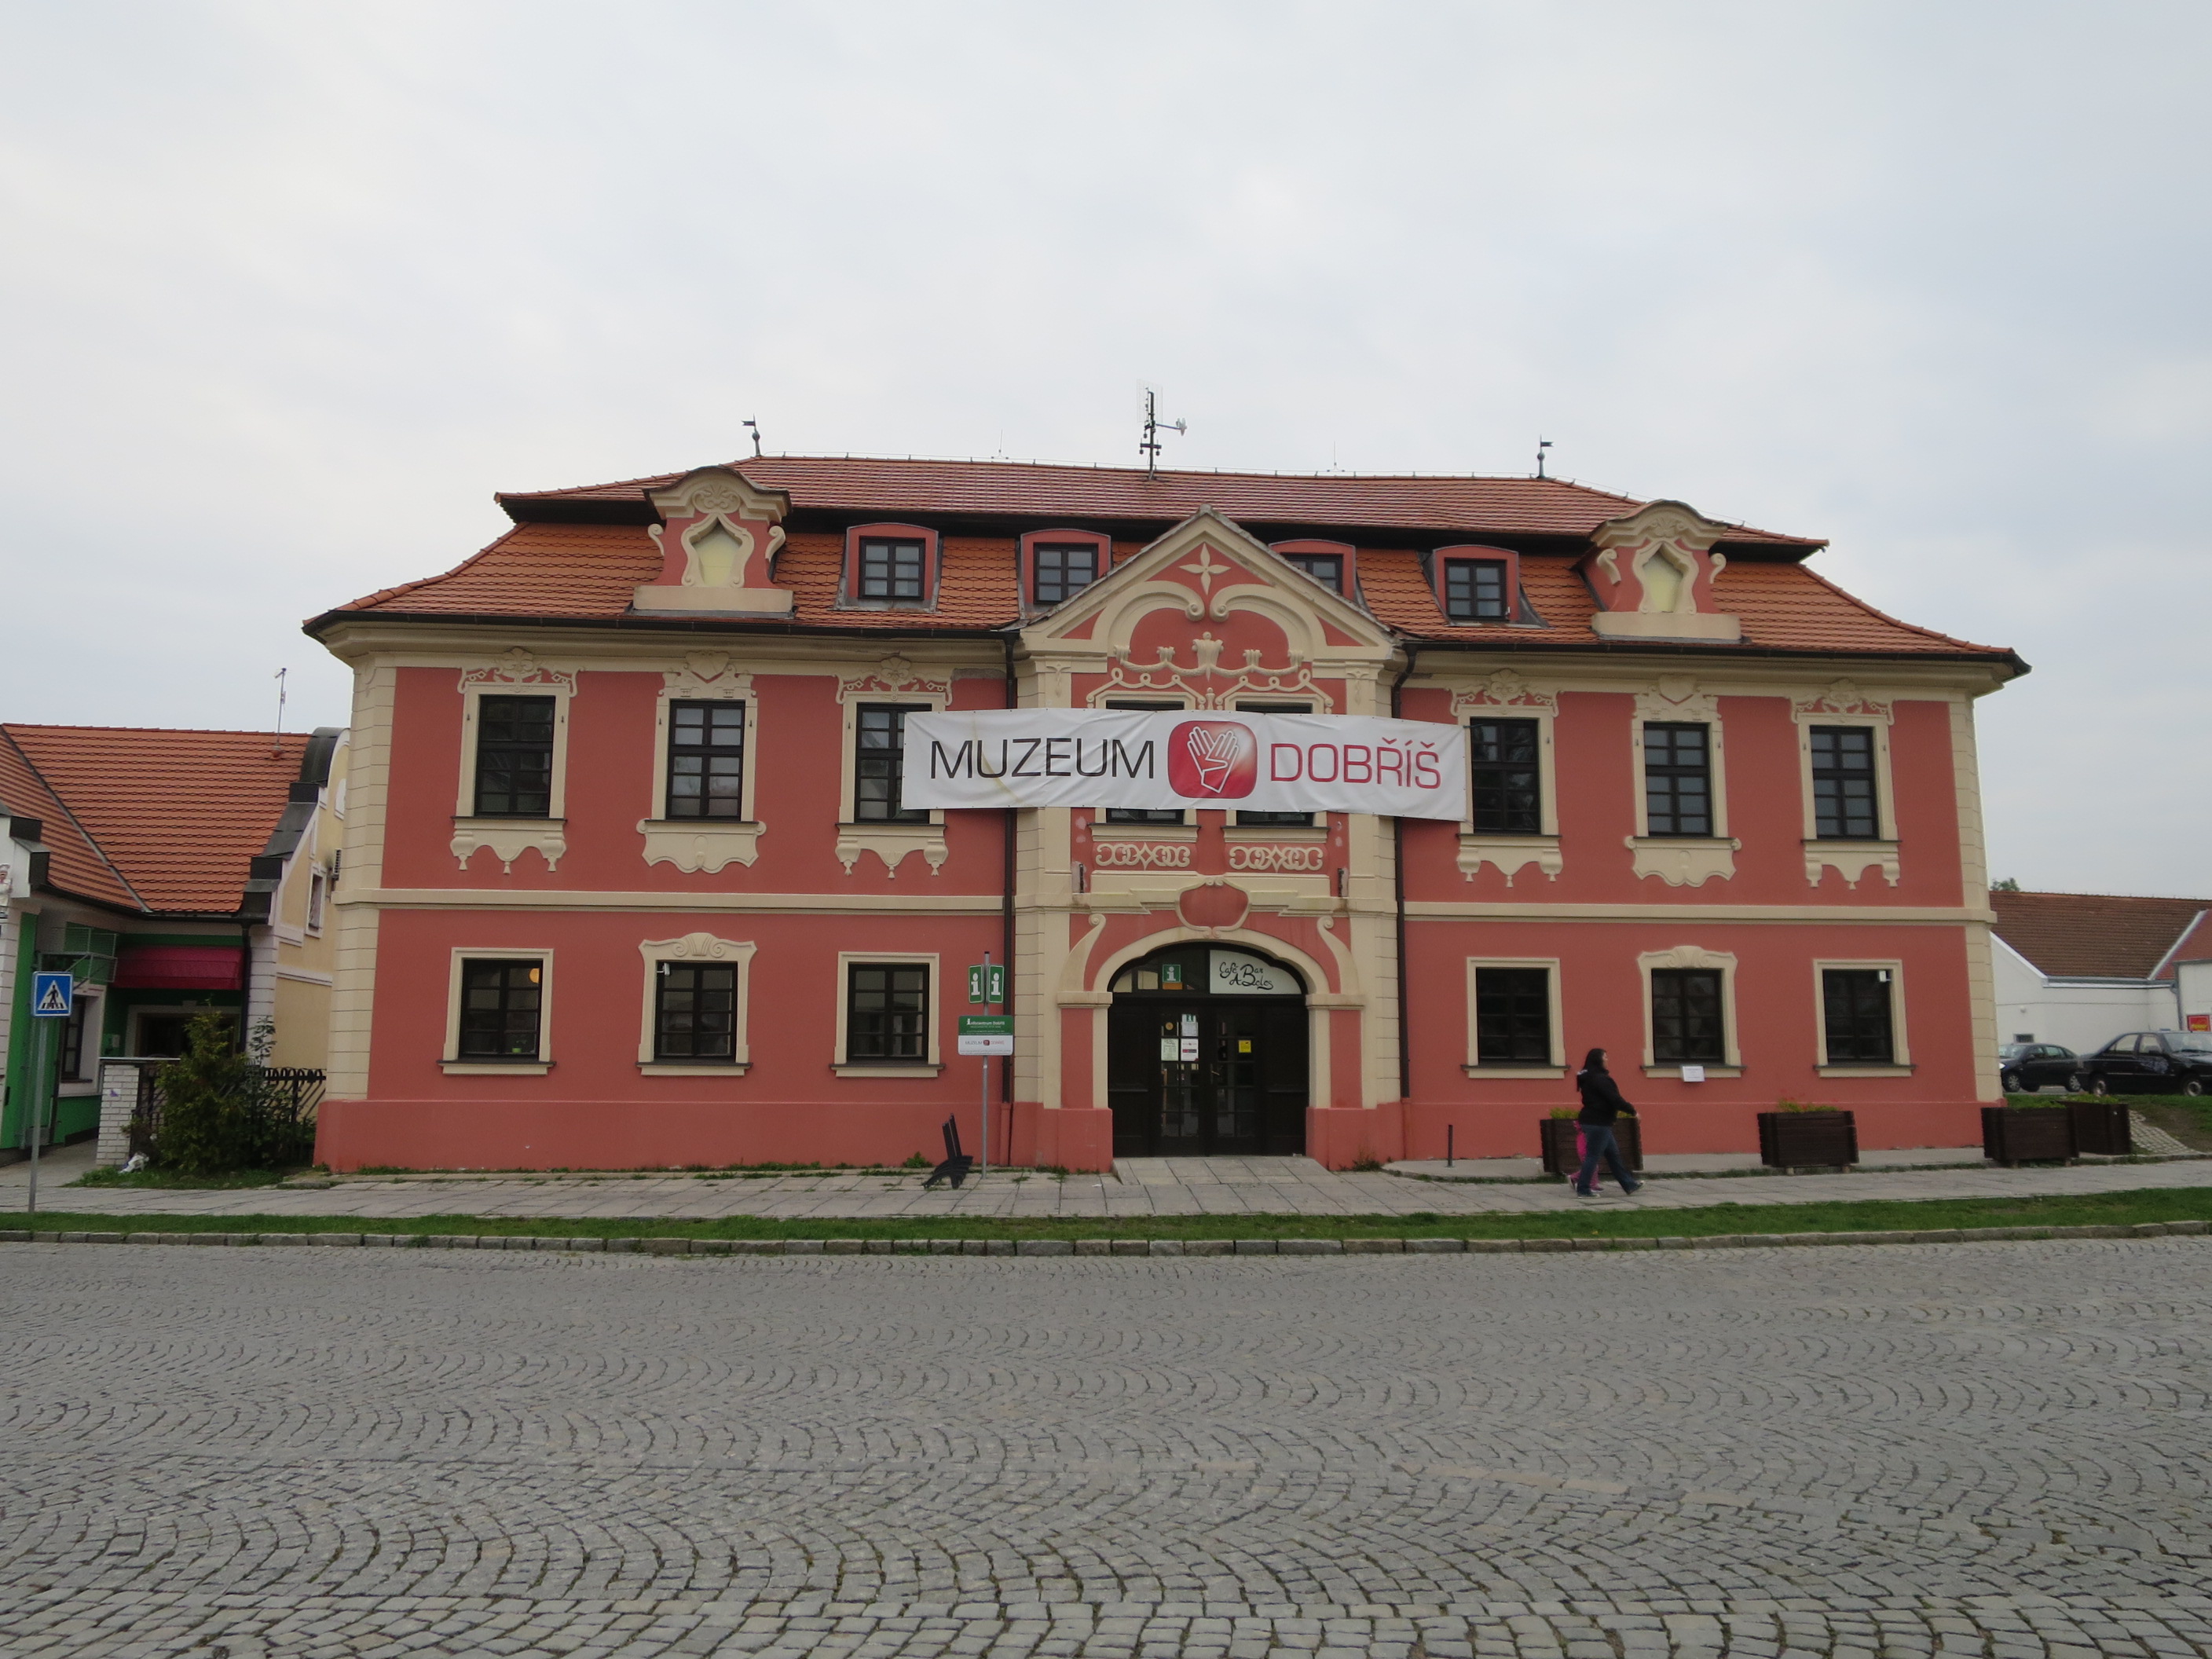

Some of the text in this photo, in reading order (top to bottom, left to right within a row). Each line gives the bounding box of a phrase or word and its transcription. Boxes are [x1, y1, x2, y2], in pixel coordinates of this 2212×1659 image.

[930, 736, 1441, 789] MUZEUM DOBŘÍŠ
[1219, 961, 1239, 979] Café
